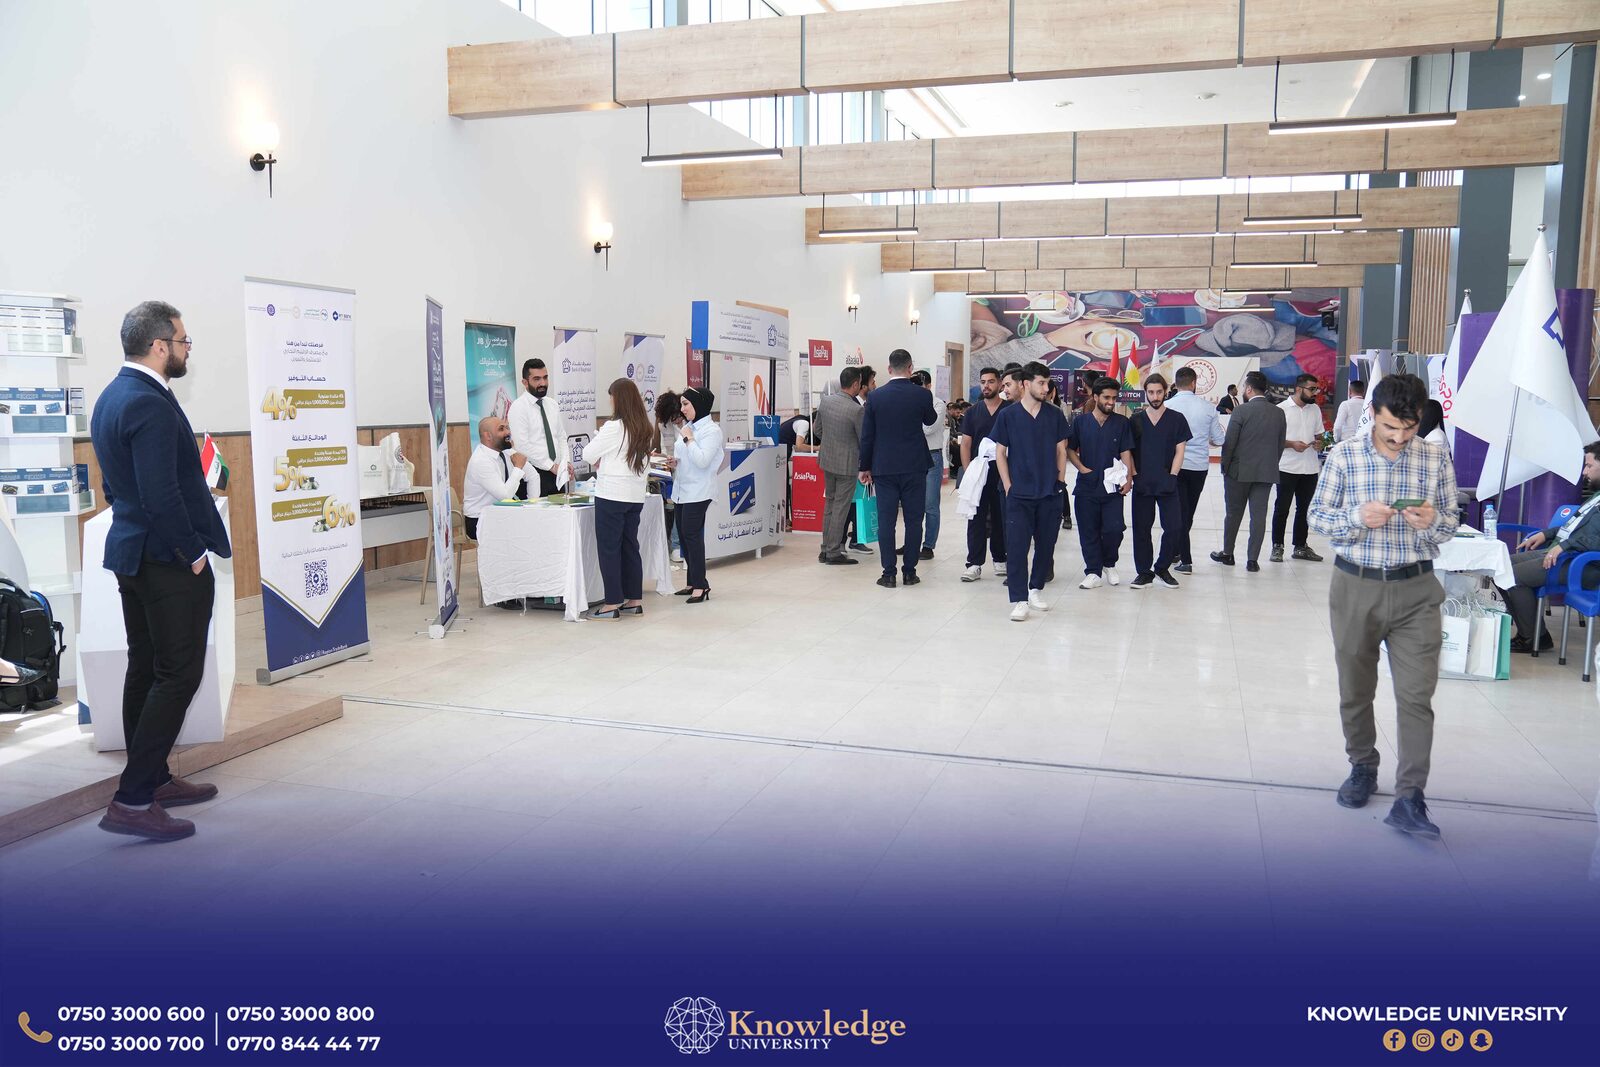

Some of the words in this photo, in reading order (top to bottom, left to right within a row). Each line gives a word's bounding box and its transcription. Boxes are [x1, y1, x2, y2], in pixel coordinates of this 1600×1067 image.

[261, 386, 297, 421] 4%
[794, 472, 817, 482] AsiaPay
[323, 495, 356, 529] 6%
